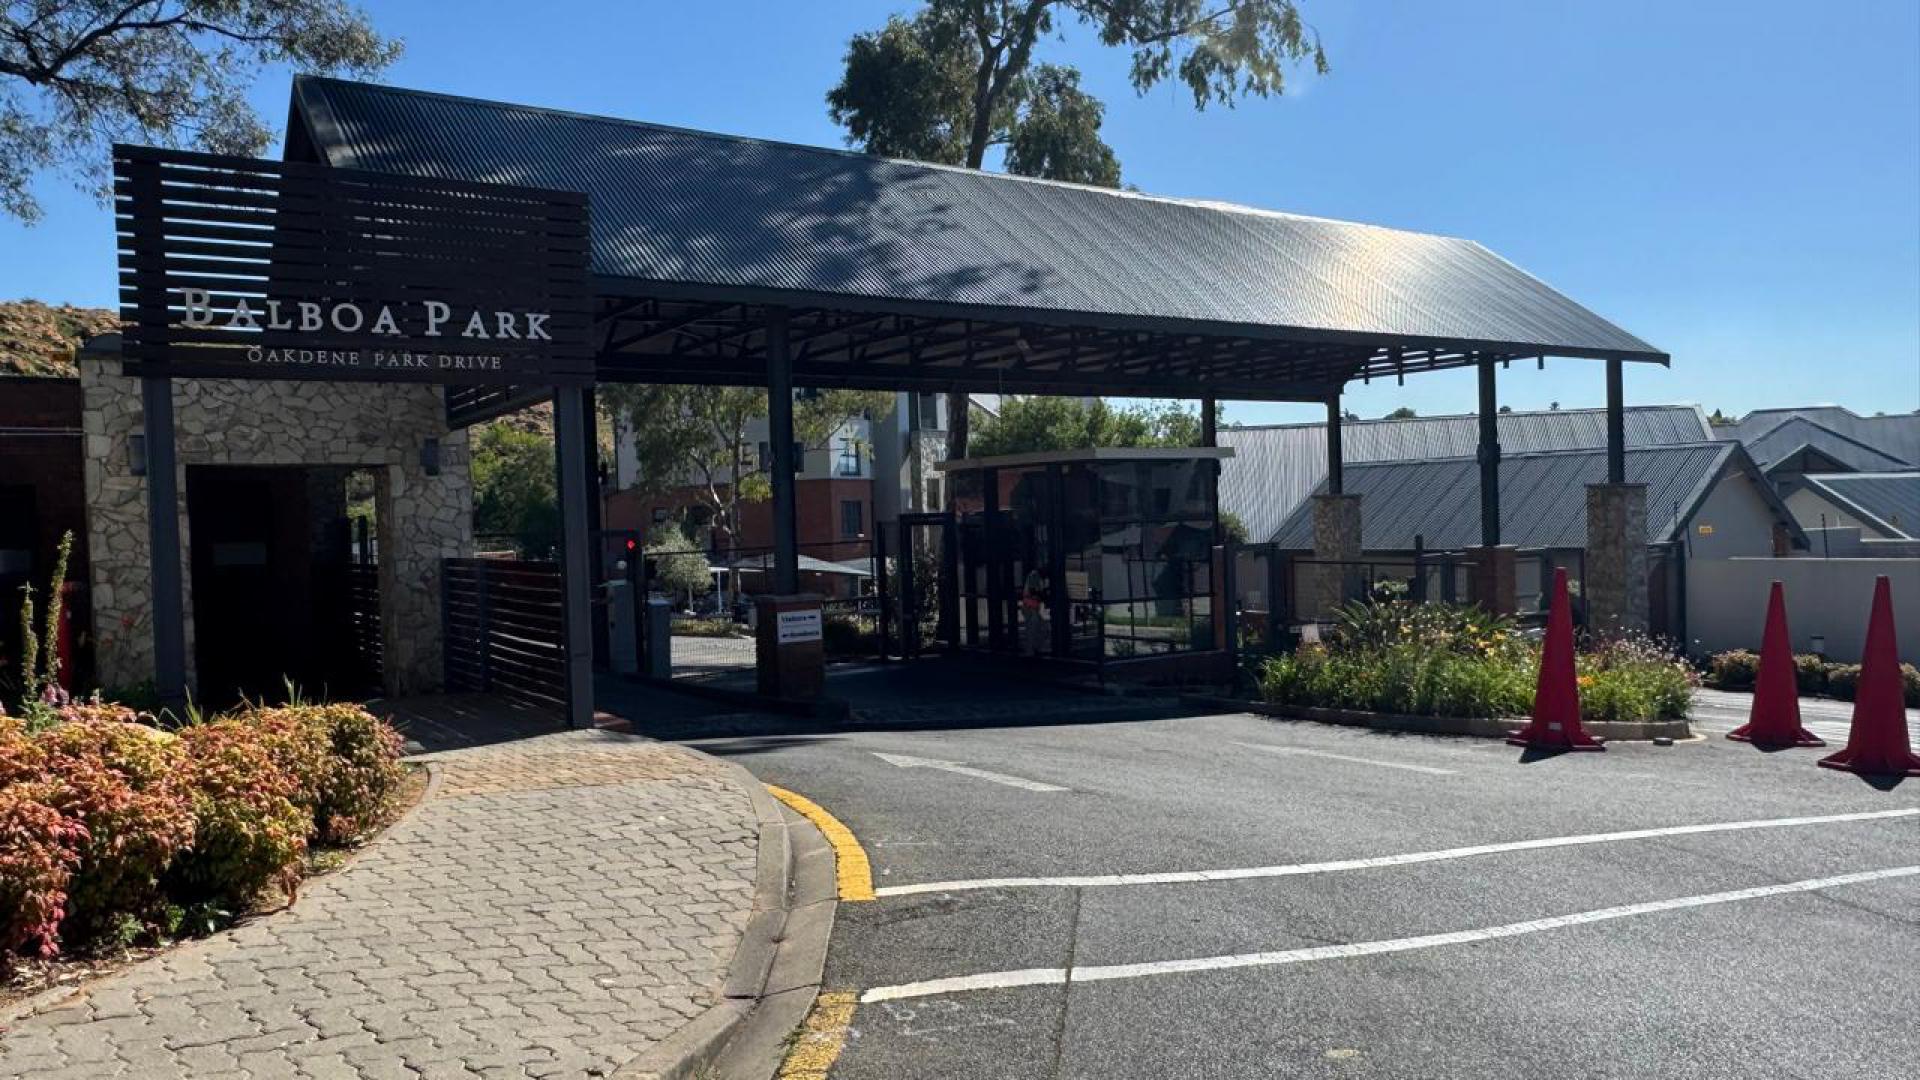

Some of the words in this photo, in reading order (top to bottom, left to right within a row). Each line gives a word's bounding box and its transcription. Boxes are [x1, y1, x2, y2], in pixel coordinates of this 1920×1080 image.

[179, 287, 402, 335] BALBOA
[422, 300, 553, 340] PARK
[247, 347, 360, 366] OAKDENE
[374, 352, 432, 368] PARK
[438, 354, 502, 370] DRIVE
